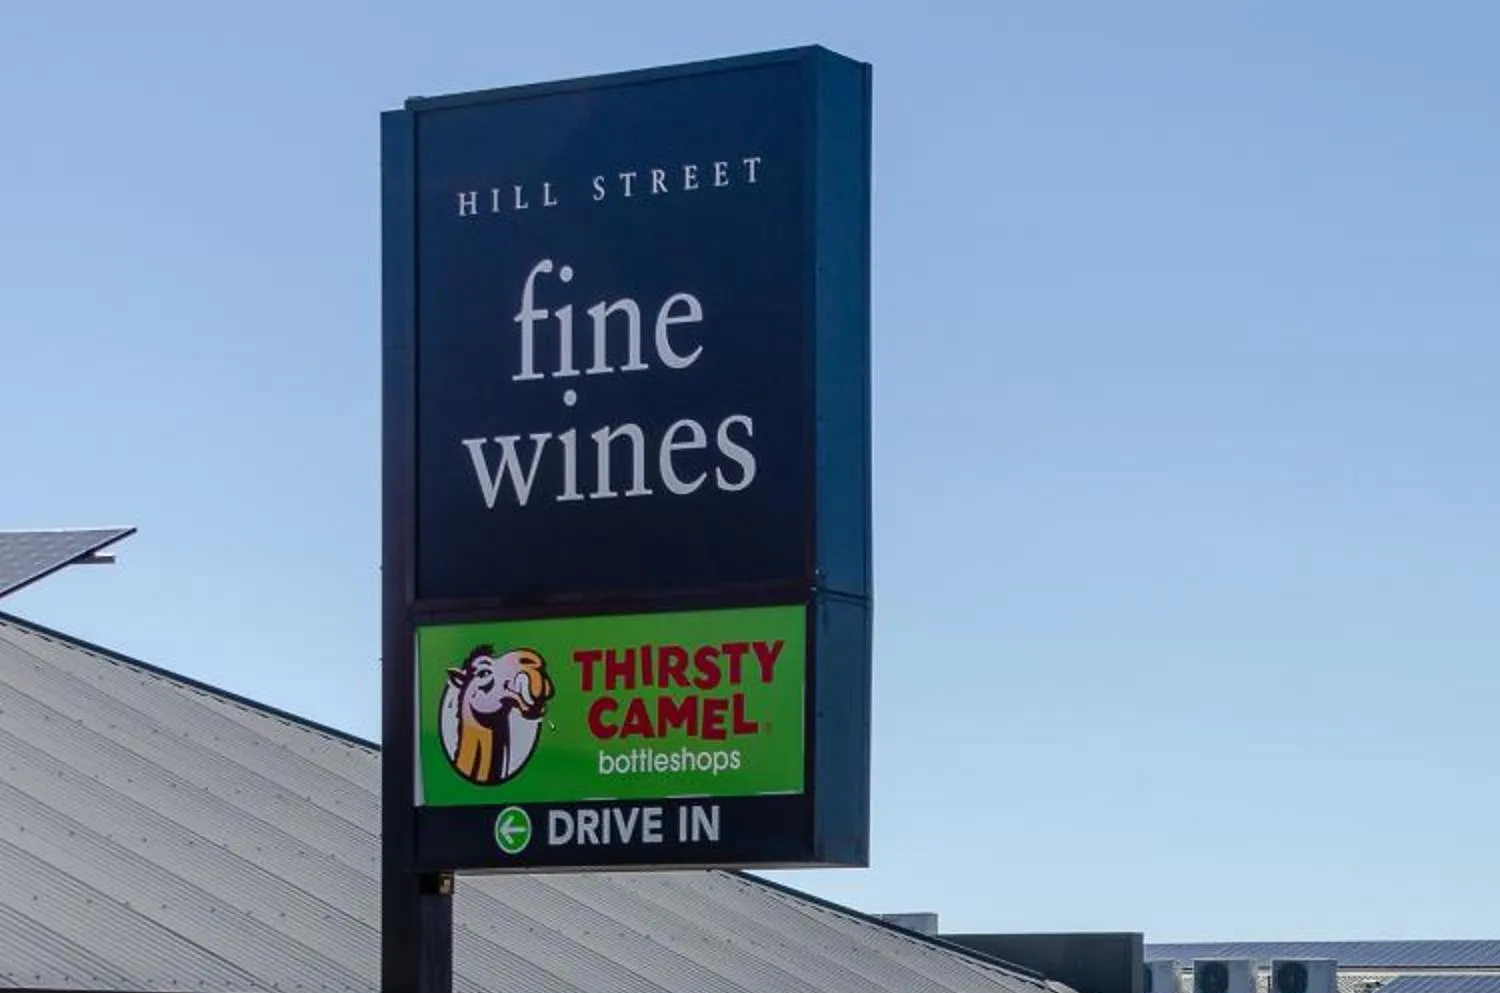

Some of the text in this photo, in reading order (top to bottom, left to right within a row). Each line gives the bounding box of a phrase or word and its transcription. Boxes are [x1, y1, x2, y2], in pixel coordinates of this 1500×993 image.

[458, 157, 762, 217] HILL STREET
[512, 259, 704, 381] fine
[461, 389, 758, 509] wines
[573, 639, 785, 693] THIRSTY
[587, 692, 759, 742] CAMEL
[598, 747, 742, 776] bottleshops
[547, 805, 721, 846] DRIVE IN
